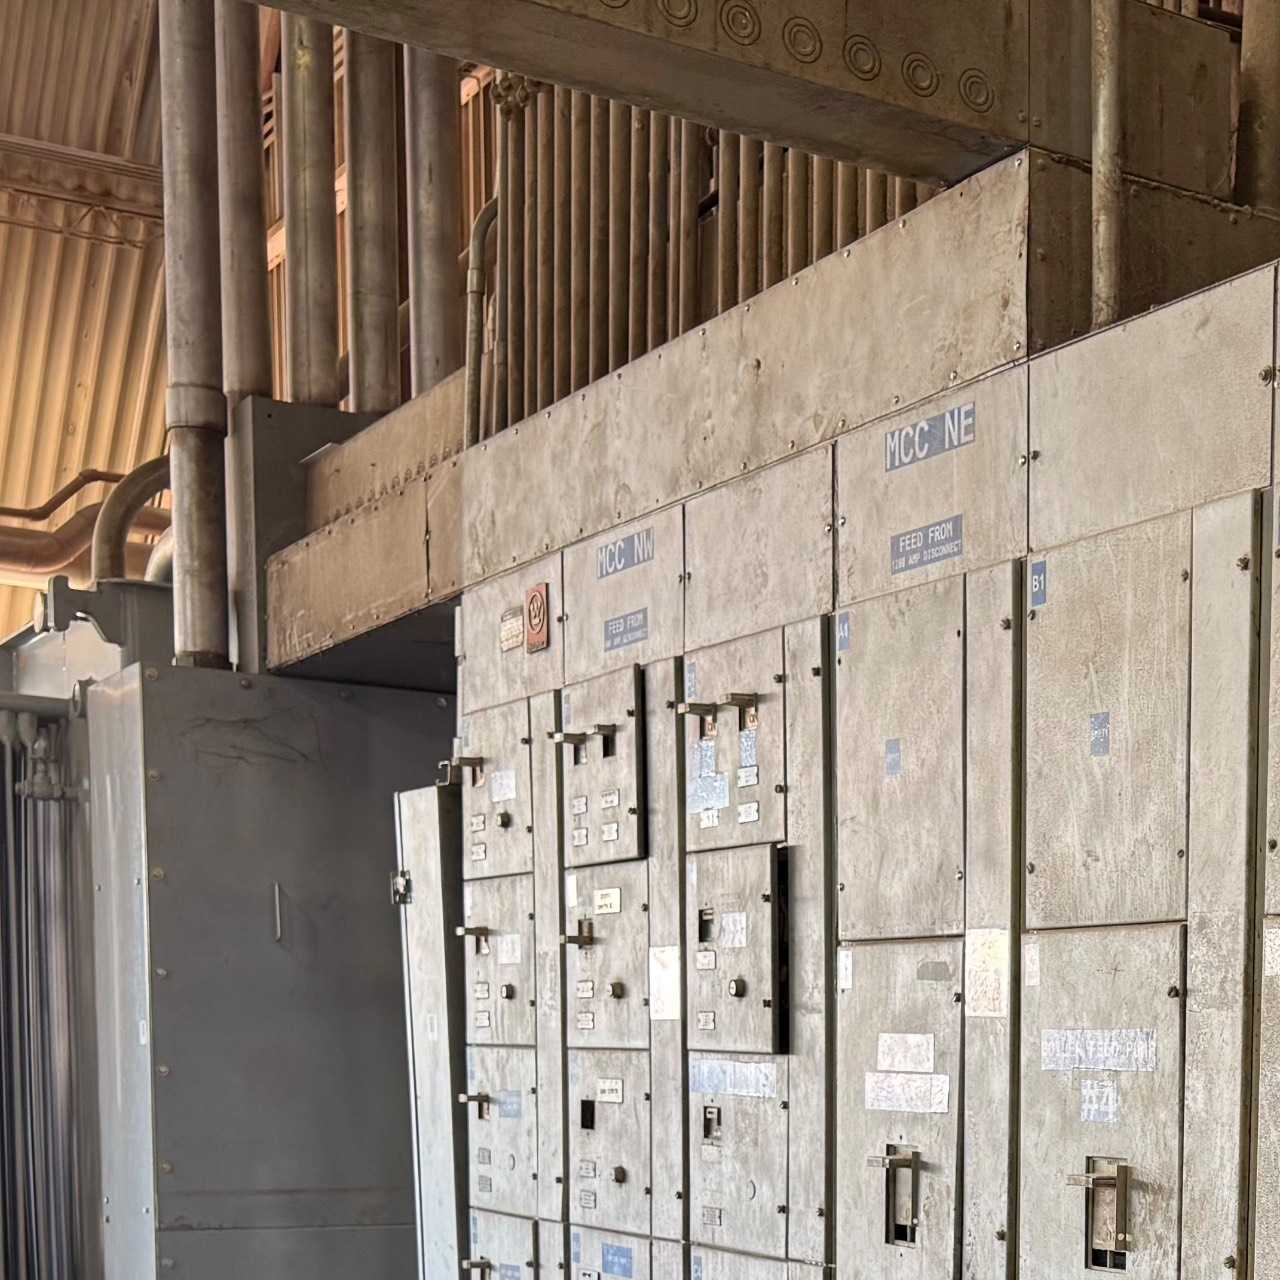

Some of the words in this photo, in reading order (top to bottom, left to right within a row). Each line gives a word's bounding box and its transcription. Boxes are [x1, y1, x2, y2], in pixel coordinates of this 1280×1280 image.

[885, 420, 930, 470] MCC
[944, 402, 975, 450] NE
[899, 531, 923, 553] FEED
[928, 521, 953, 545] FROM
[597, 540, 625, 577] MCC
[634, 529, 655, 564] NW
[923, 540, 962, 562] DISCONNECT
[1033, 574, 1044, 592] B1
[608, 618, 625, 635] FEED
[627, 612, 644, 630] FROM
[1086, 1039, 1120, 1058] FEED
